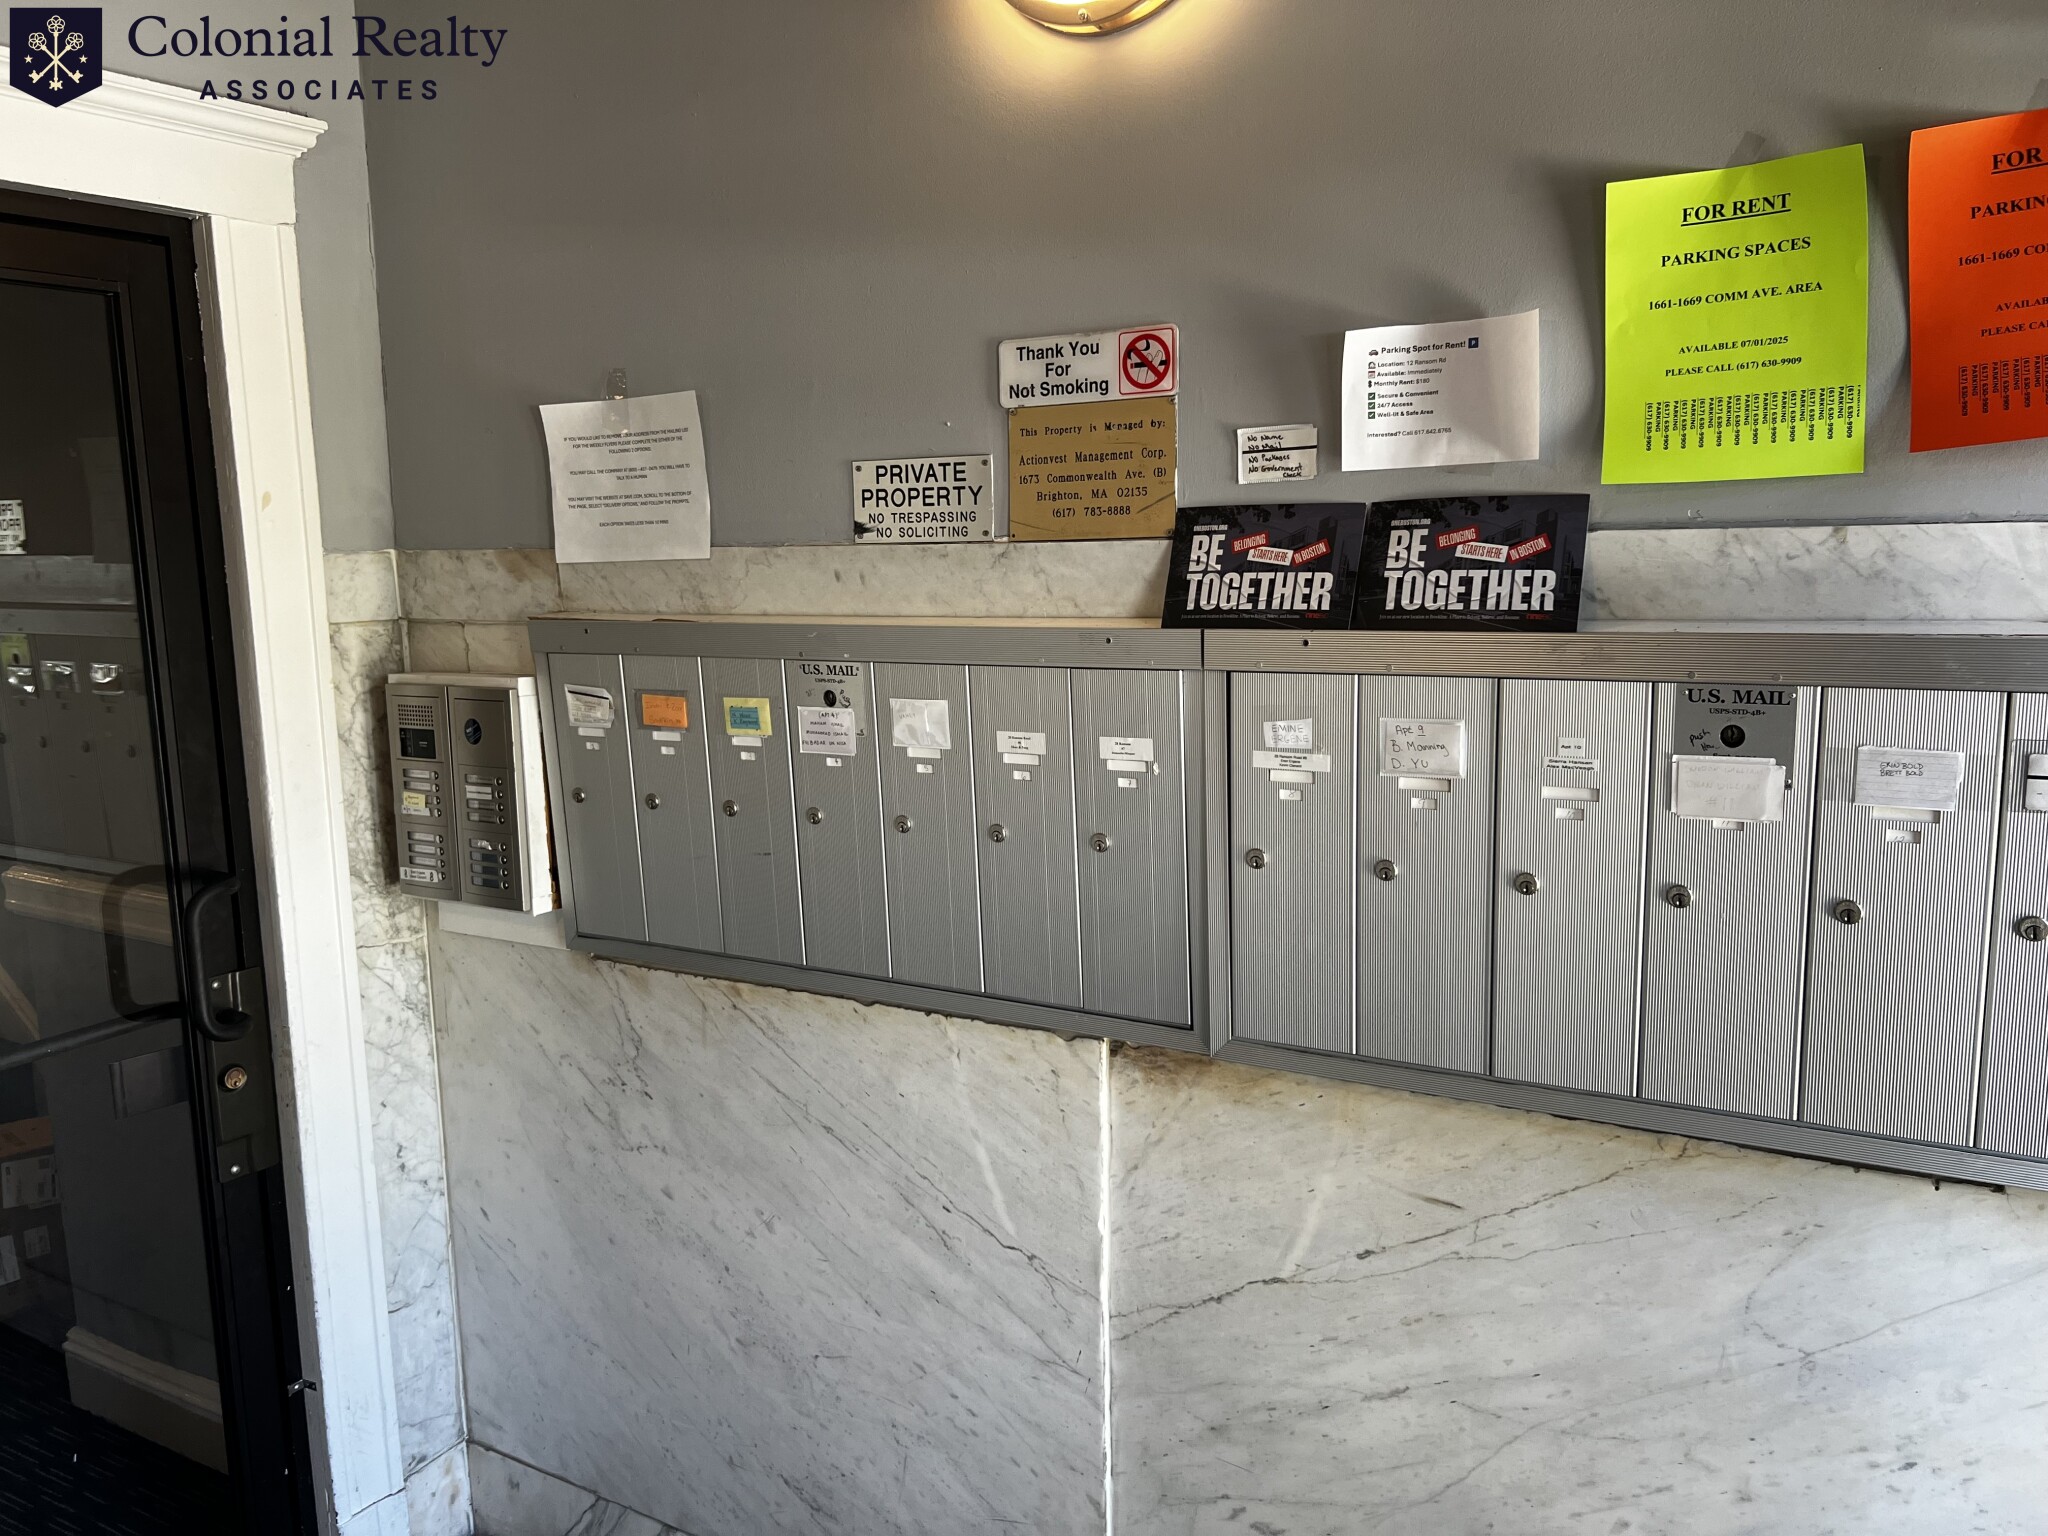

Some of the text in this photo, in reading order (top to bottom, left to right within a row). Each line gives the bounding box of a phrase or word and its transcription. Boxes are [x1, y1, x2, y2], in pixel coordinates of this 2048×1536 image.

[1991, 147, 2042, 171] FOR
[1682, 192, 1791, 223] FOR RENT
[1970, 195, 2048, 220] PARKIN
[1661, 236, 1811, 268] PARKING SPACES
[1958, 243, 2048, 267] 1661-1669 CO
[1649, 281, 1823, 310] 1661-1669 COMM AVE. AREA
[1980, 323, 2026, 338] PLEASE
[1016, 341, 1100, 361] Thank You
[1381, 346, 1411, 354] Parking
[1412, 344, 1431, 353] Spot
[1432, 343, 1443, 351] for
[1445, 341, 1466, 350] Rent!
[1678, 335, 1789, 355] AVAILABLE 07/01/2025
[1045, 363, 1071, 377] For
[1377, 360, 1405, 368] Location:
[1407, 368, 1442, 376] Immediately
[1665, 356, 1802, 377] PLEASE CALL (617) 630-9909
[1009, 378, 1109, 399] Not Smoking
[1374, 380, 1398, 388] Monthly
[1405, 390, 1439, 398] Convenient
[1020, 428, 1038, 437] This
[1044, 426, 1083, 436] Property
[1089, 424, 1097, 433] is
[1150, 418, 1166, 428] by:
[1262, 441, 1282, 450] Mail
[1019, 447, 1167, 466] Actionvest Management Corp.
[1248, 454, 1290, 463] No Packages
[876, 462, 967, 484] PRIVATE
[1019, 467, 1167, 484] 1673 Commonwealth Ave. (B)
[1248, 462, 1303, 474] No Government
[862, 485, 983, 508] PROPERTY
[1091, 489, 1108, 499] MA
[1117, 486, 1148, 498] 02135
[868, 511, 977, 524] NO TRESPASSING
[1052, 505, 1131, 518] (617) 783-8888
[876, 526, 969, 538] NO SOLICITING
[1438, 528, 1476, 547] BELONGING
[1233, 534, 1266, 552] BELONGING
[1385, 528, 1429, 569] BE
[1460, 544, 1503, 558] STARTS HERE
[1509, 537, 1547, 561] IN BOSTON
[1188, 534, 1226, 571] BE
[1251, 549, 1288, 562] STARTS HERE
[1293, 542, 1327, 564] IN BOSTON
[1186, 572, 1334, 611] TOGETHER
[1383, 569, 1557, 611] TOGETHER
[801, 663, 858, 677] U.S. MAIL
[1687, 688, 1791, 706] U.S. MAIL
[1709, 707, 1766, 717] USPS-STD-4B+
[1395, 724, 1425, 736] Apt 9
[1406, 741, 1449, 757] Manning
[1391, 758, 1405, 769] D.
